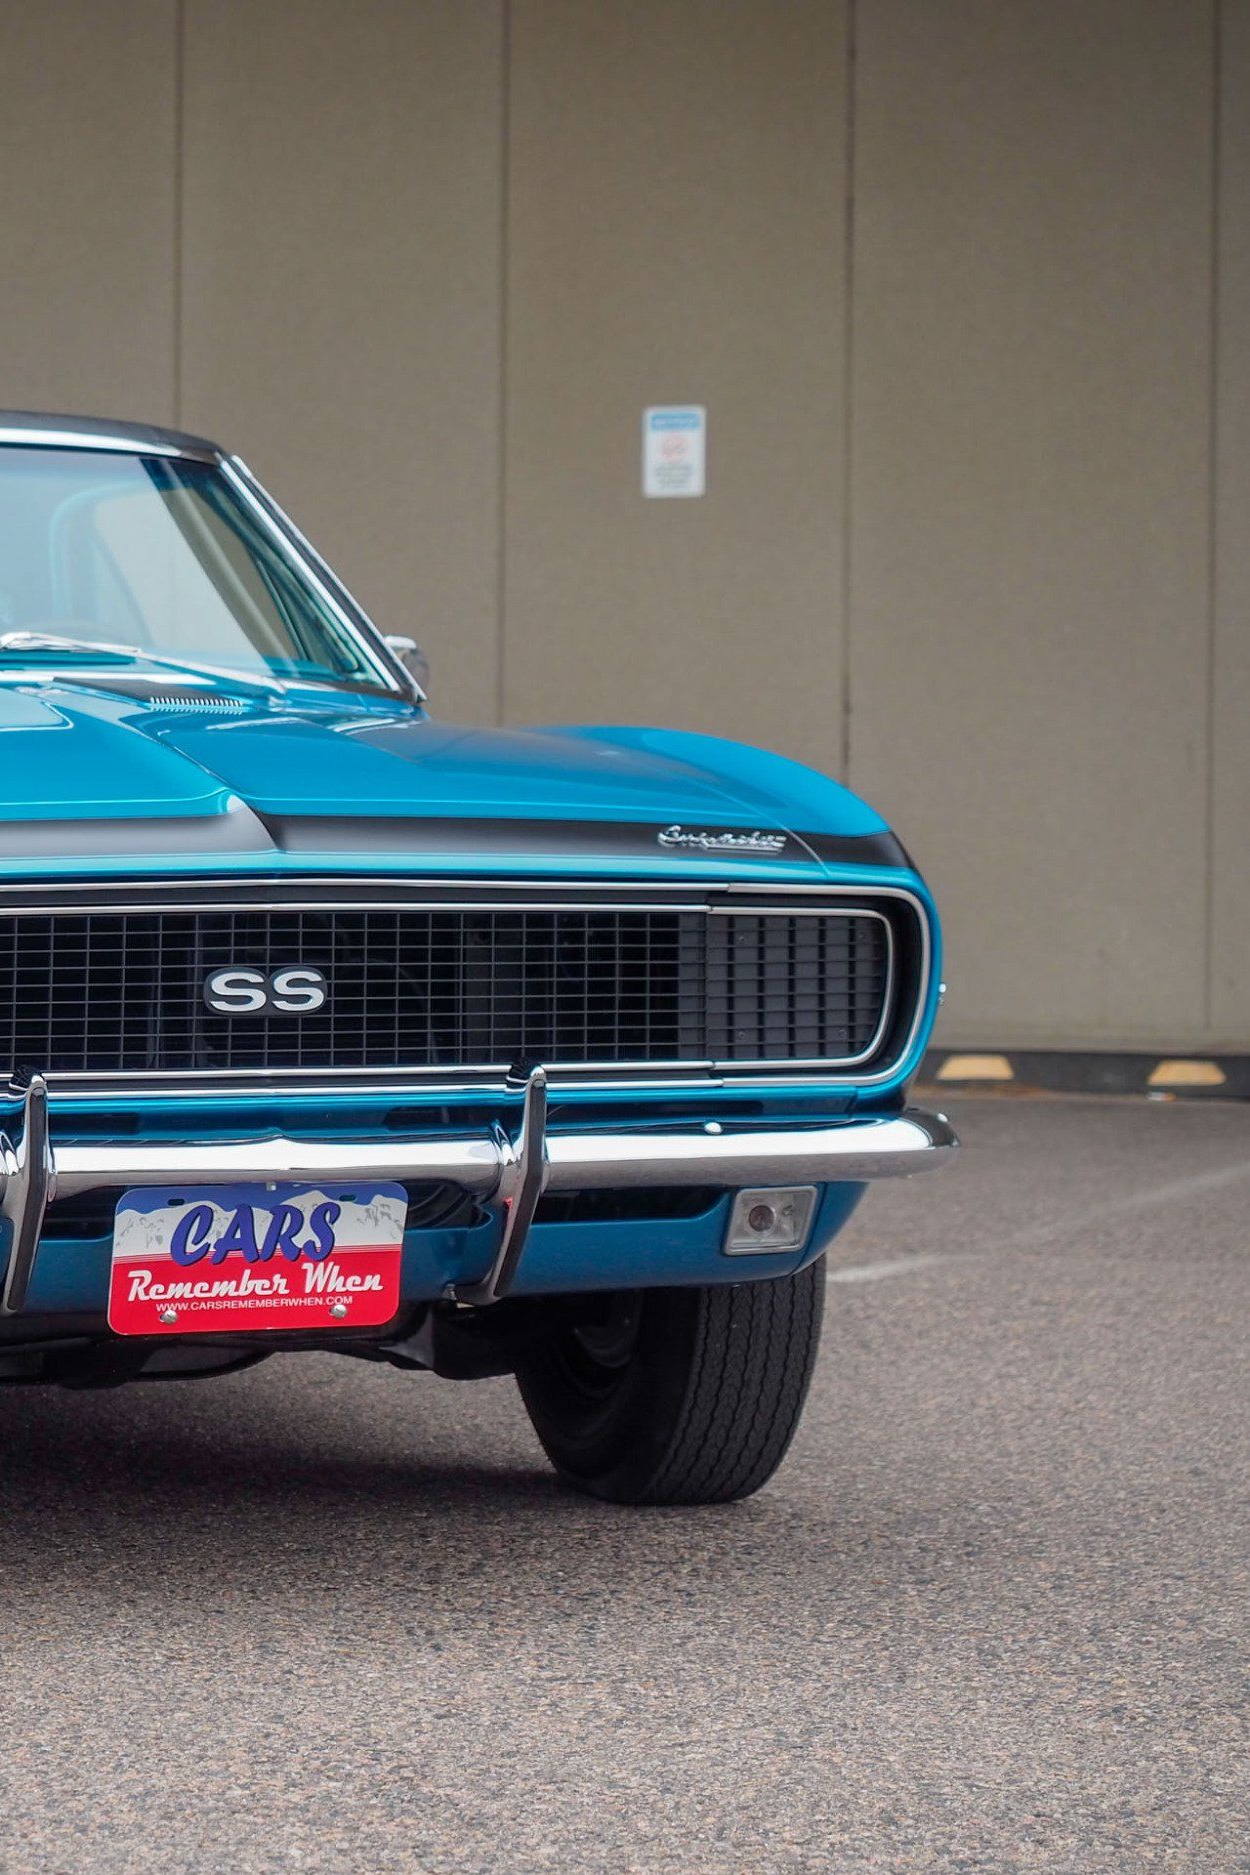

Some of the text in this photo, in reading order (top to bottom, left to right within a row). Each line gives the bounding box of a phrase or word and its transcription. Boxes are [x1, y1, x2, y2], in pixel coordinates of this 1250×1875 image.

[209, 970, 325, 1013] SS
[170, 1201, 341, 1266] CARS
[127, 1261, 384, 1302] Remember When
[155, 1295, 354, 1313] WWW.CARSREMEMBERWHEN.COM
